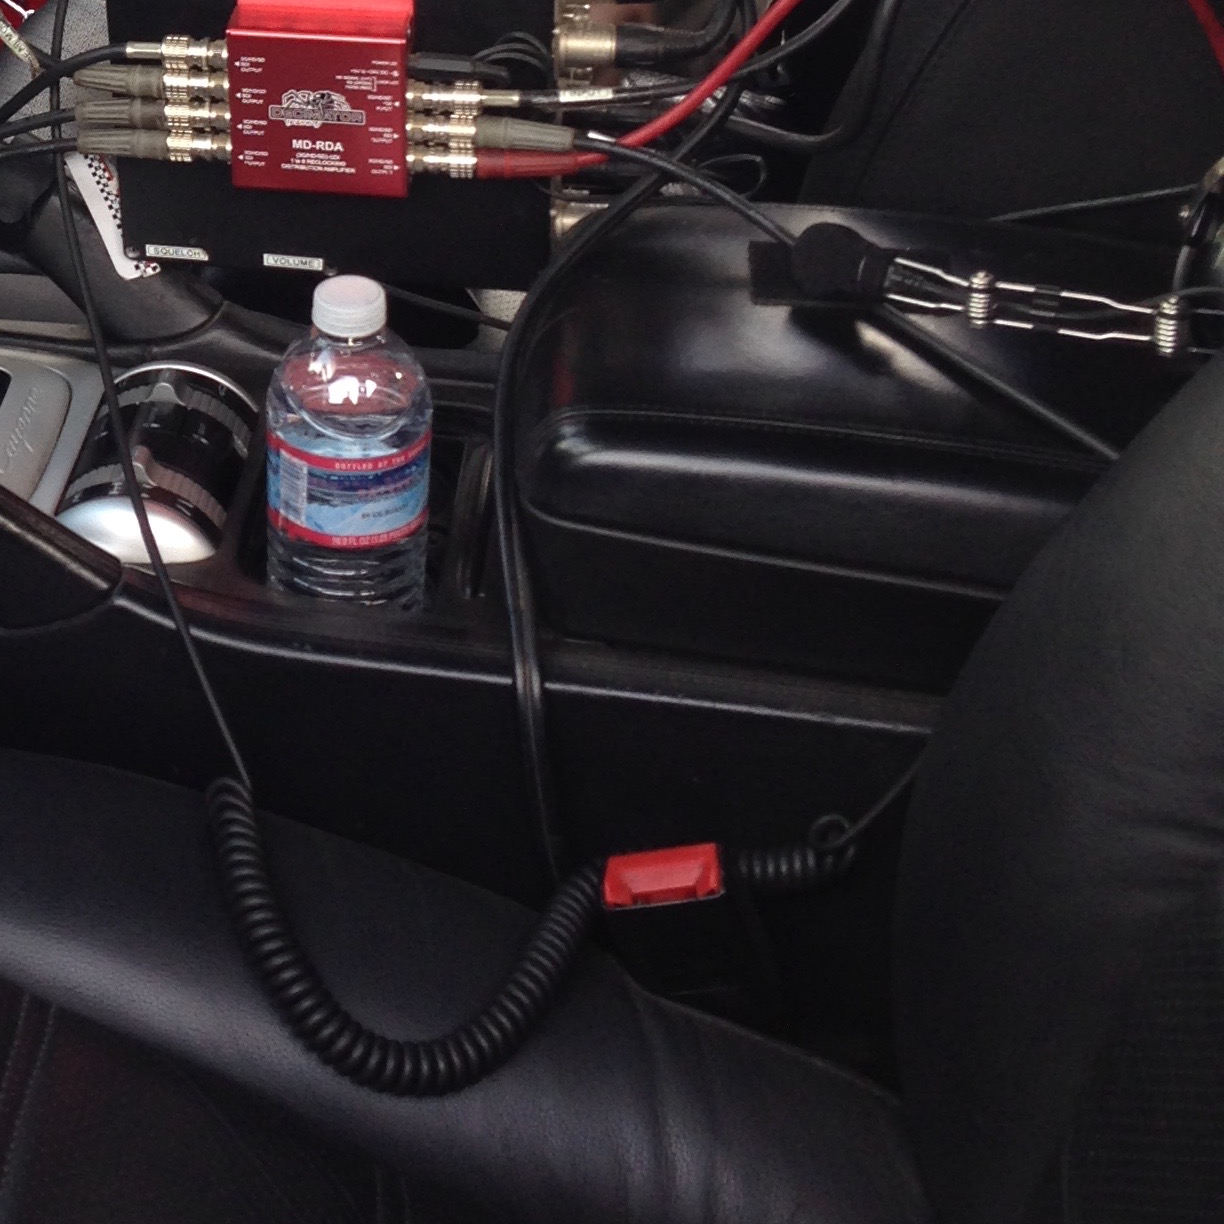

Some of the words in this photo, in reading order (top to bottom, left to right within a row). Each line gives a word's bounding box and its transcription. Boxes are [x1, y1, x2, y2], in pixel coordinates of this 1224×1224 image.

[292, 139, 344, 152] MD-RDA
[153, 247, 201, 258] SQUELCH
[273, 258, 315, 268] VOLUME
